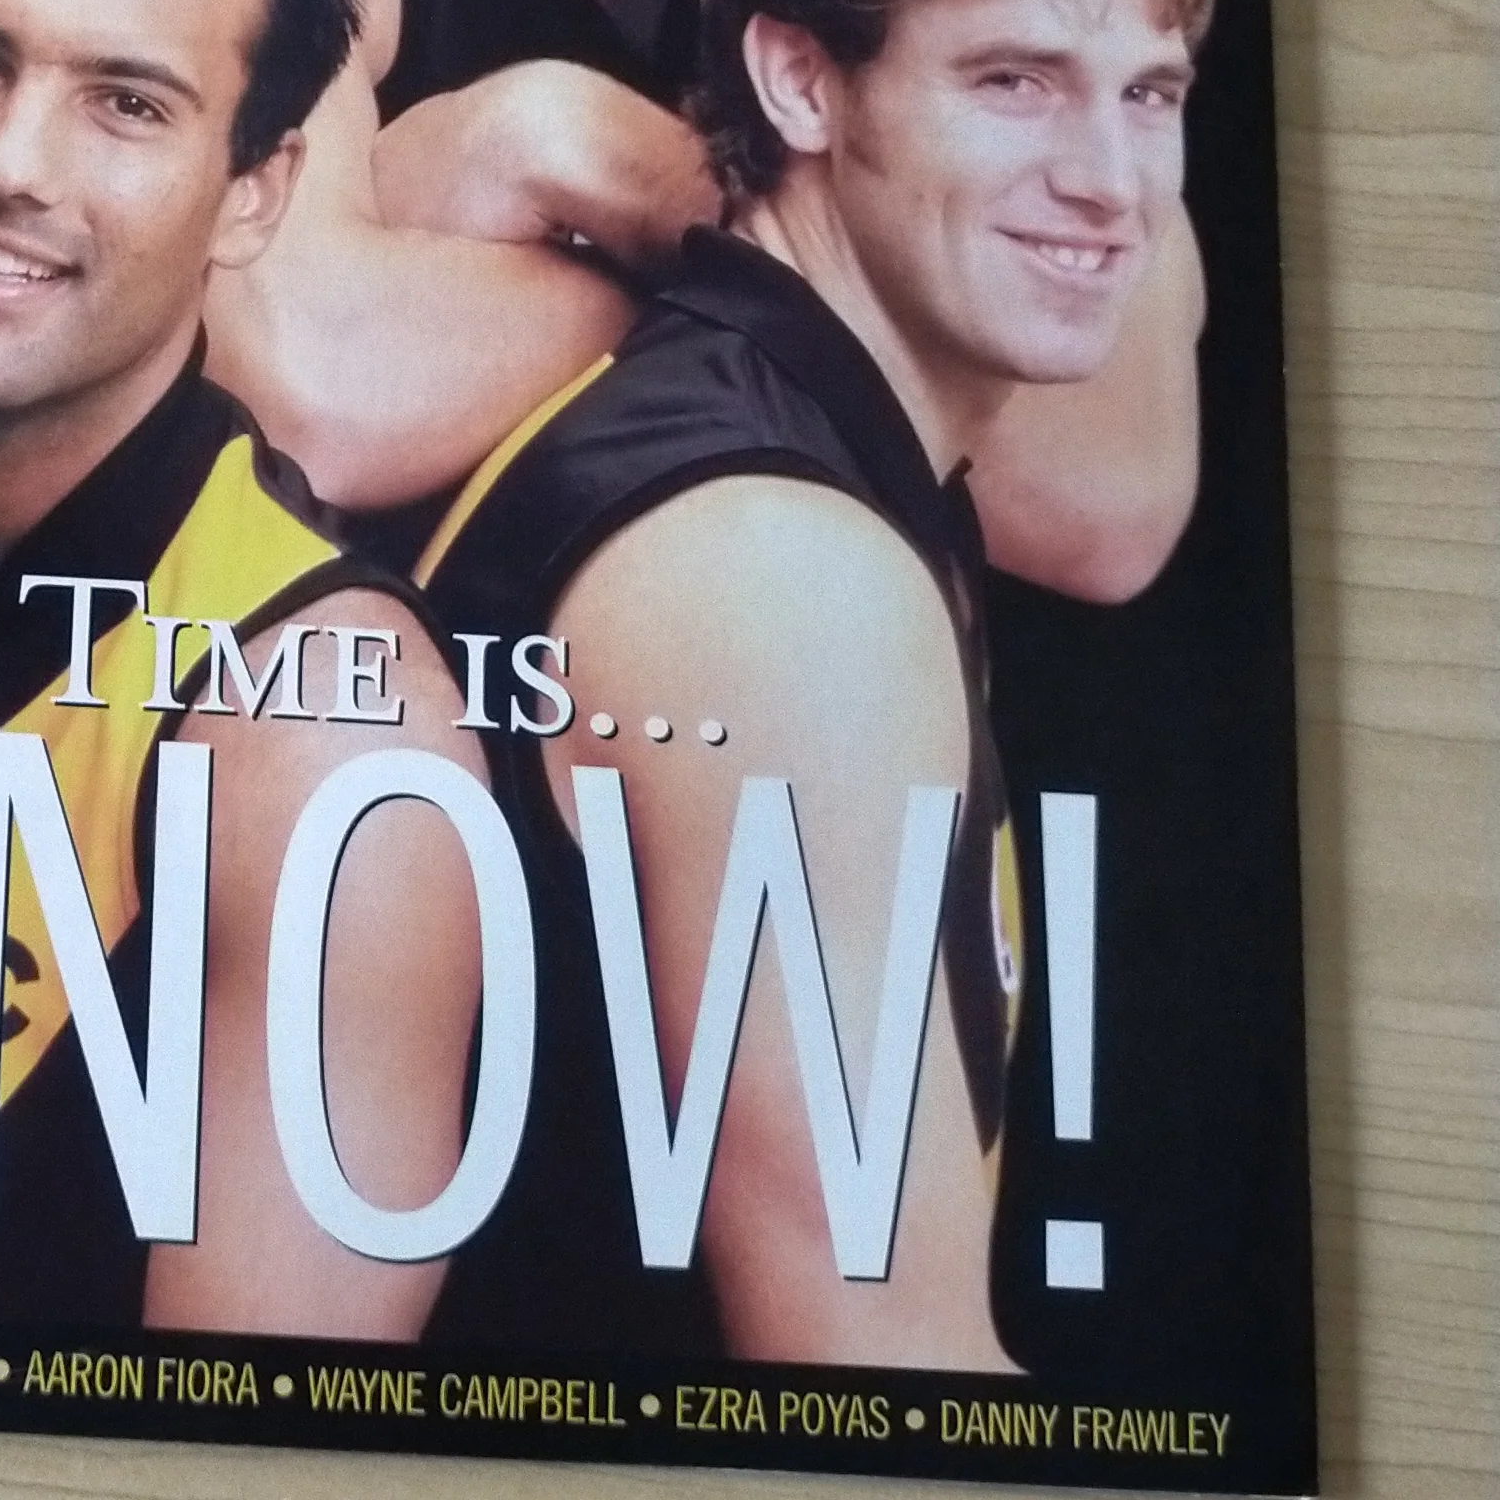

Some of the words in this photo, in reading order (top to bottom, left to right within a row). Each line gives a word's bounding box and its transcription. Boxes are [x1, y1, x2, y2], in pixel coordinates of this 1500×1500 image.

[23, 1350, 145, 1402] AARON
[156, 1356, 259, 1407] FIORA
[307, 1365, 427, 1418] WAYNE
[439, 1372, 627, 1428] CAMPBELL
[676, 1384, 768, 1435] EZRA
[779, 1392, 892, 1442] POYAS
[941, 1399, 1059, 1451] DANNY
[1071, 1405, 1231, 1459] FRAWLEY
